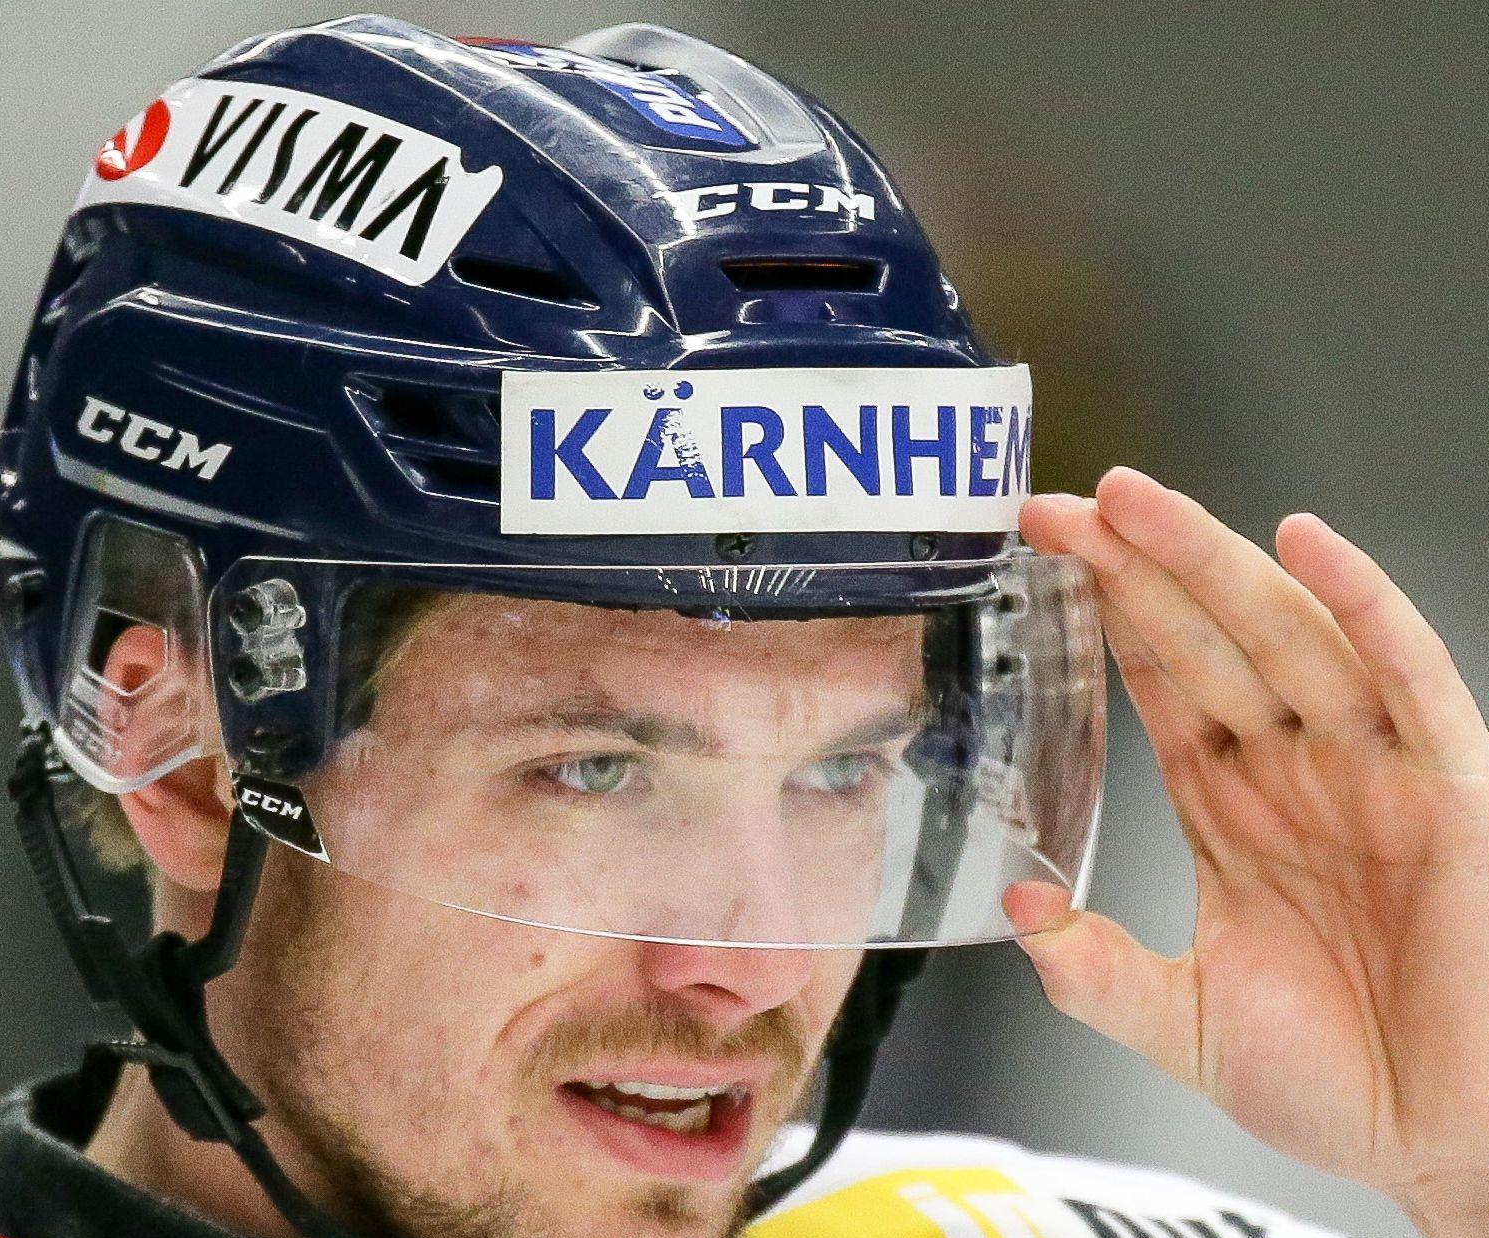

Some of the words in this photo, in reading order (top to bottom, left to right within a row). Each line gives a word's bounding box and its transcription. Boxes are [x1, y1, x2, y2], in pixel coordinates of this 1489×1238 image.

[181, 94, 453, 262] VISMA
[665, 182, 875, 222] CCM
[75, 394, 233, 482] CCM
[241, 787, 303, 821] CCM
